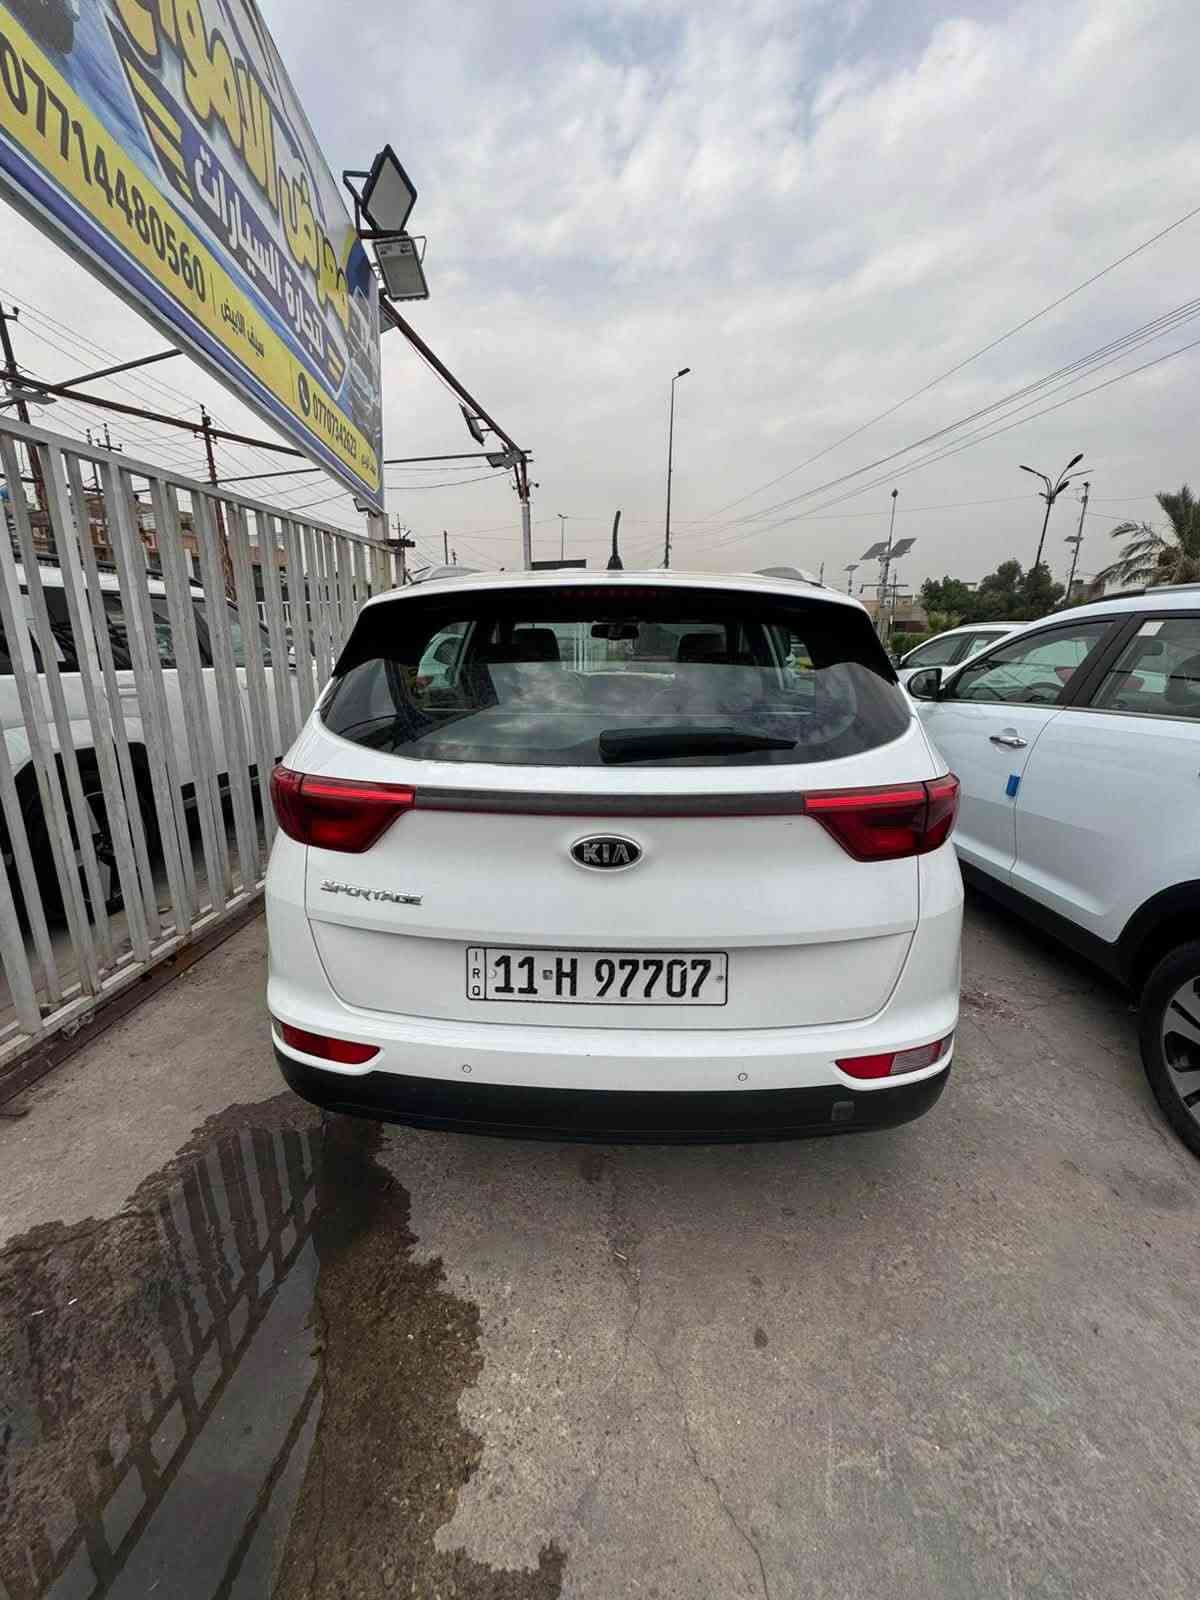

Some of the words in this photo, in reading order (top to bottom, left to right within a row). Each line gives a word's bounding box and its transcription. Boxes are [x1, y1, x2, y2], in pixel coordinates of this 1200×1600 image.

[0, 31, 206, 303] 07714480560
[194, 147, 282, 298] السيارات
[583, 842, 631, 863] KIA
[319, 879, 423, 905] SPORTAGE
[494, 955, 538, 995] 11
[555, 957, 578, 996] H
[594, 958, 712, 998] 97707
